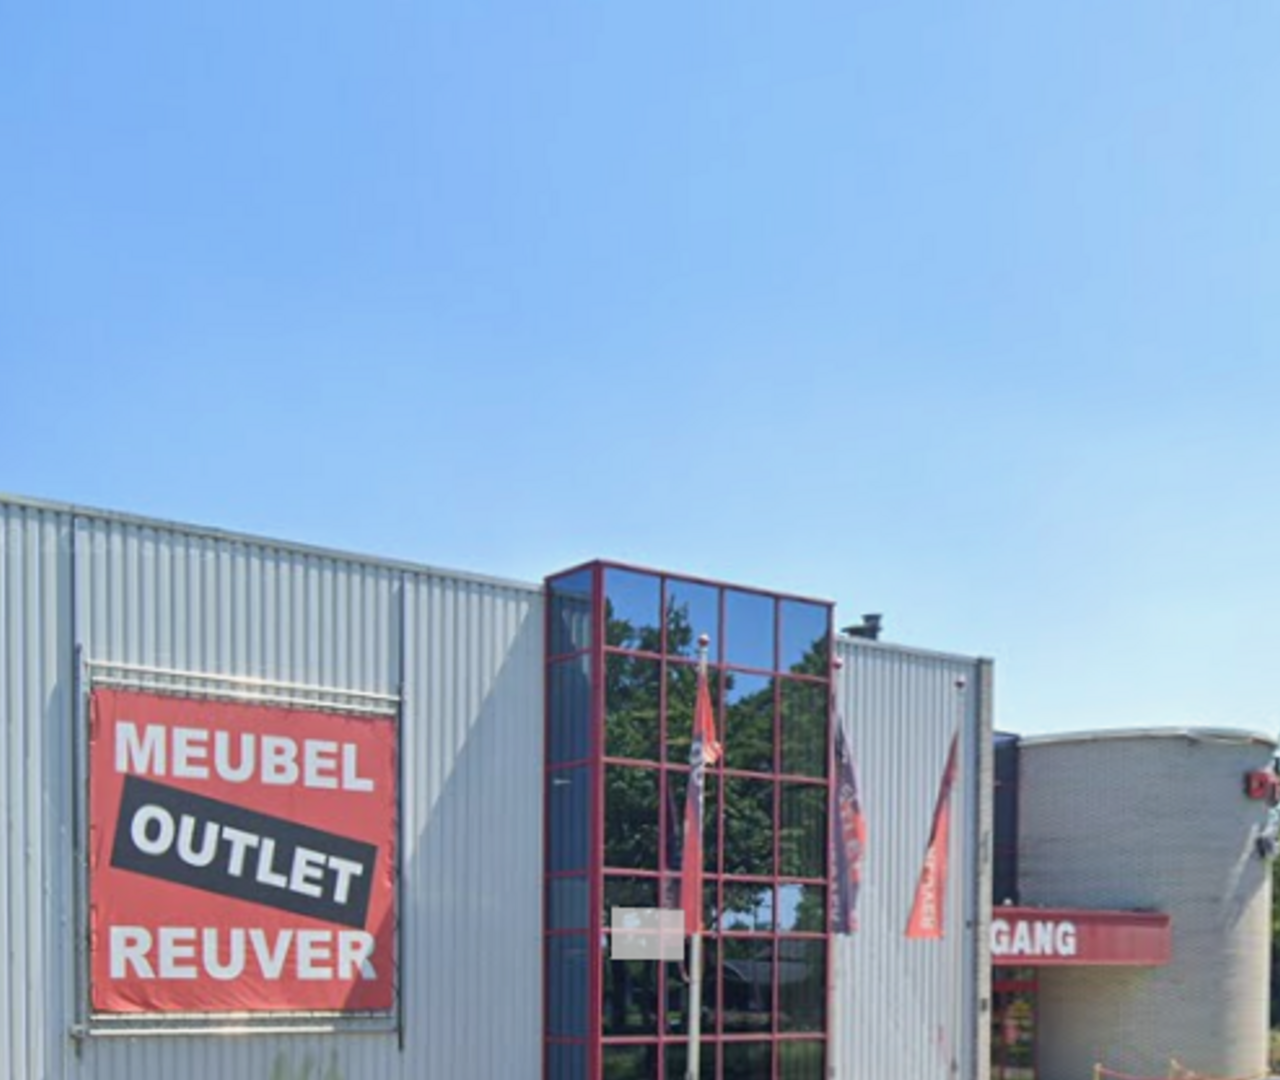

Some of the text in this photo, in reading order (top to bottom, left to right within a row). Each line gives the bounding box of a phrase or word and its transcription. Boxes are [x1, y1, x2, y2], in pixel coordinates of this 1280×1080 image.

[114, 721, 374, 792] MEUBEL
[130, 804, 363, 904] OUTLET
[109, 925, 377, 981] REUVER
[990, 918, 1076, 956] GANG
